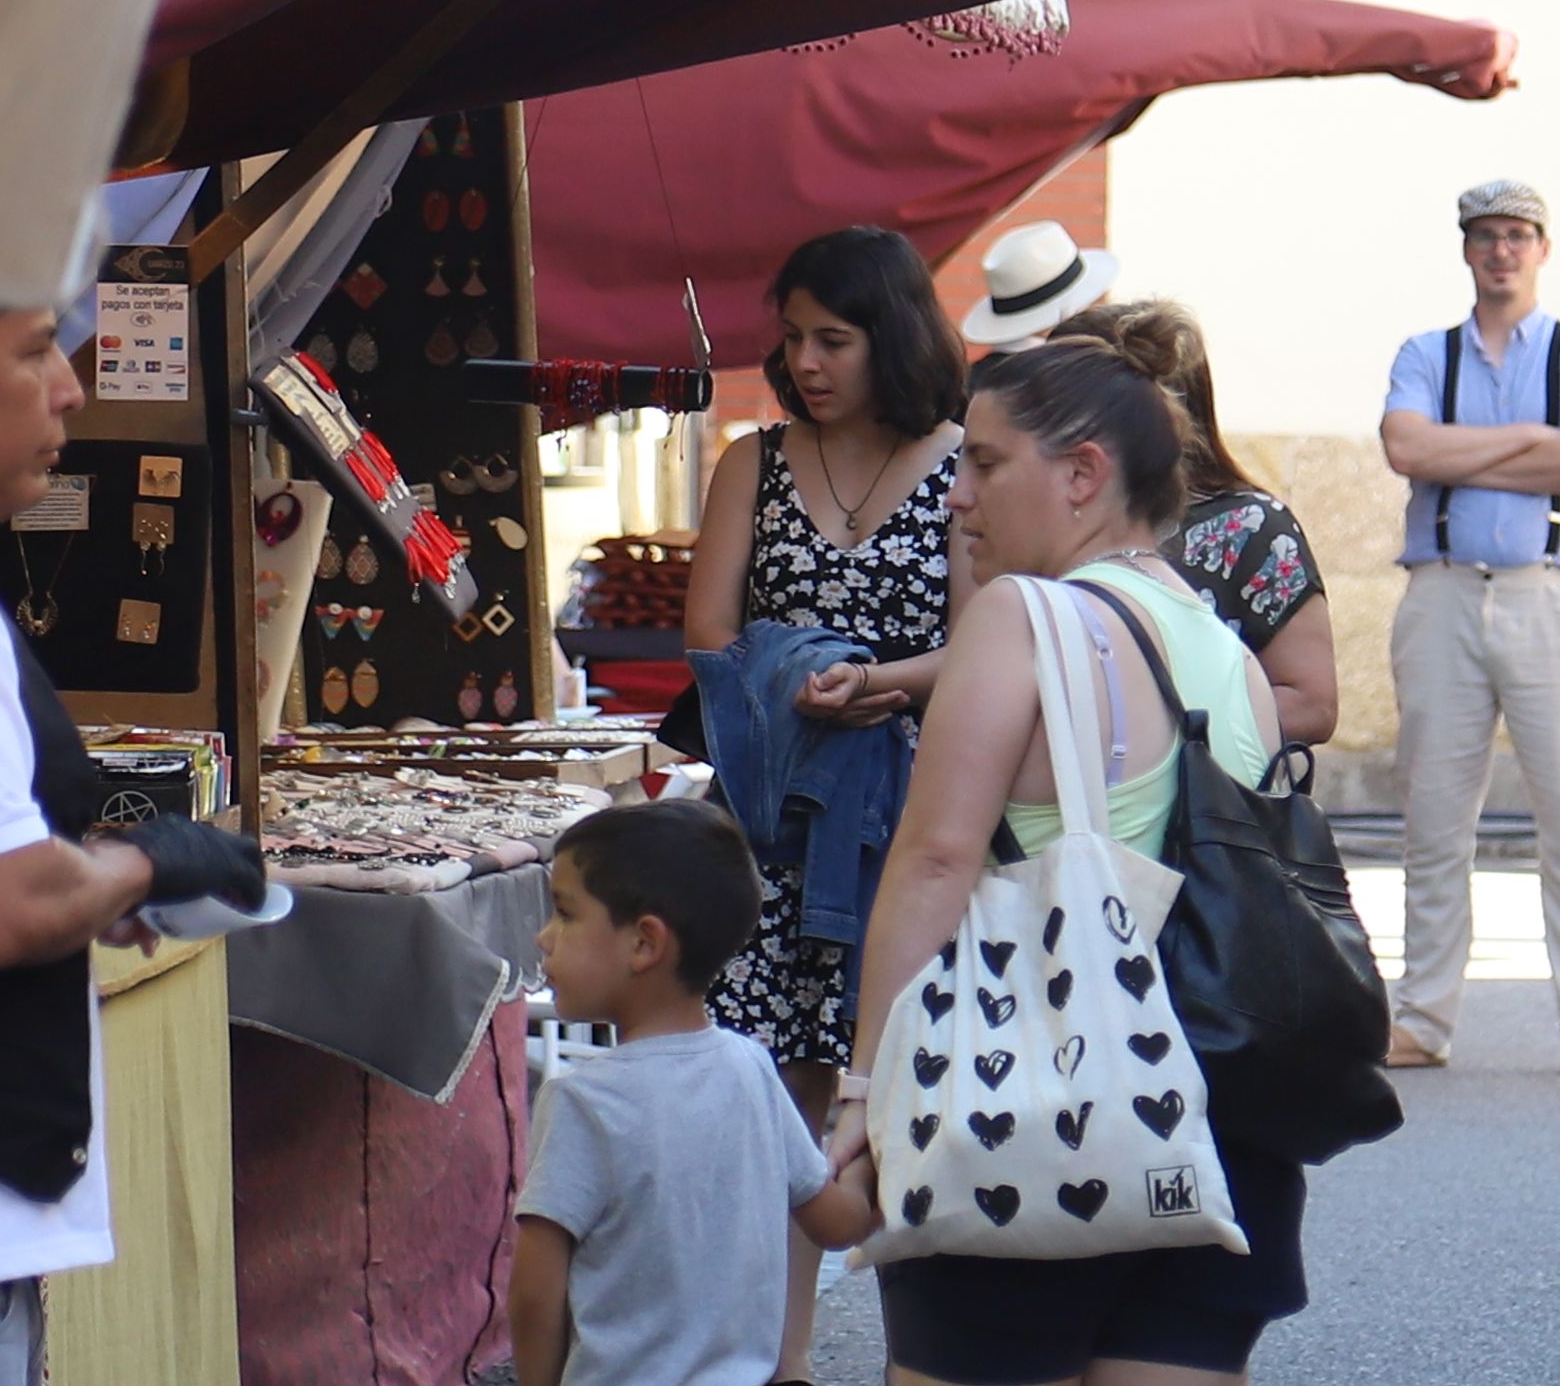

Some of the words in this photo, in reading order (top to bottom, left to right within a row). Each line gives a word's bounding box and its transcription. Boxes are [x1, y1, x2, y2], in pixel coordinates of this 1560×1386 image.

[116, 285, 129, 295] Se
[131, 286, 170, 297] aceptan
[101, 300, 130, 311] pagos
[133, 300, 152, 310] con
[153, 299, 184, 312] tarjeta
[134, 339, 155, 347] VISA
[1154, 1168, 1194, 1212] kik
